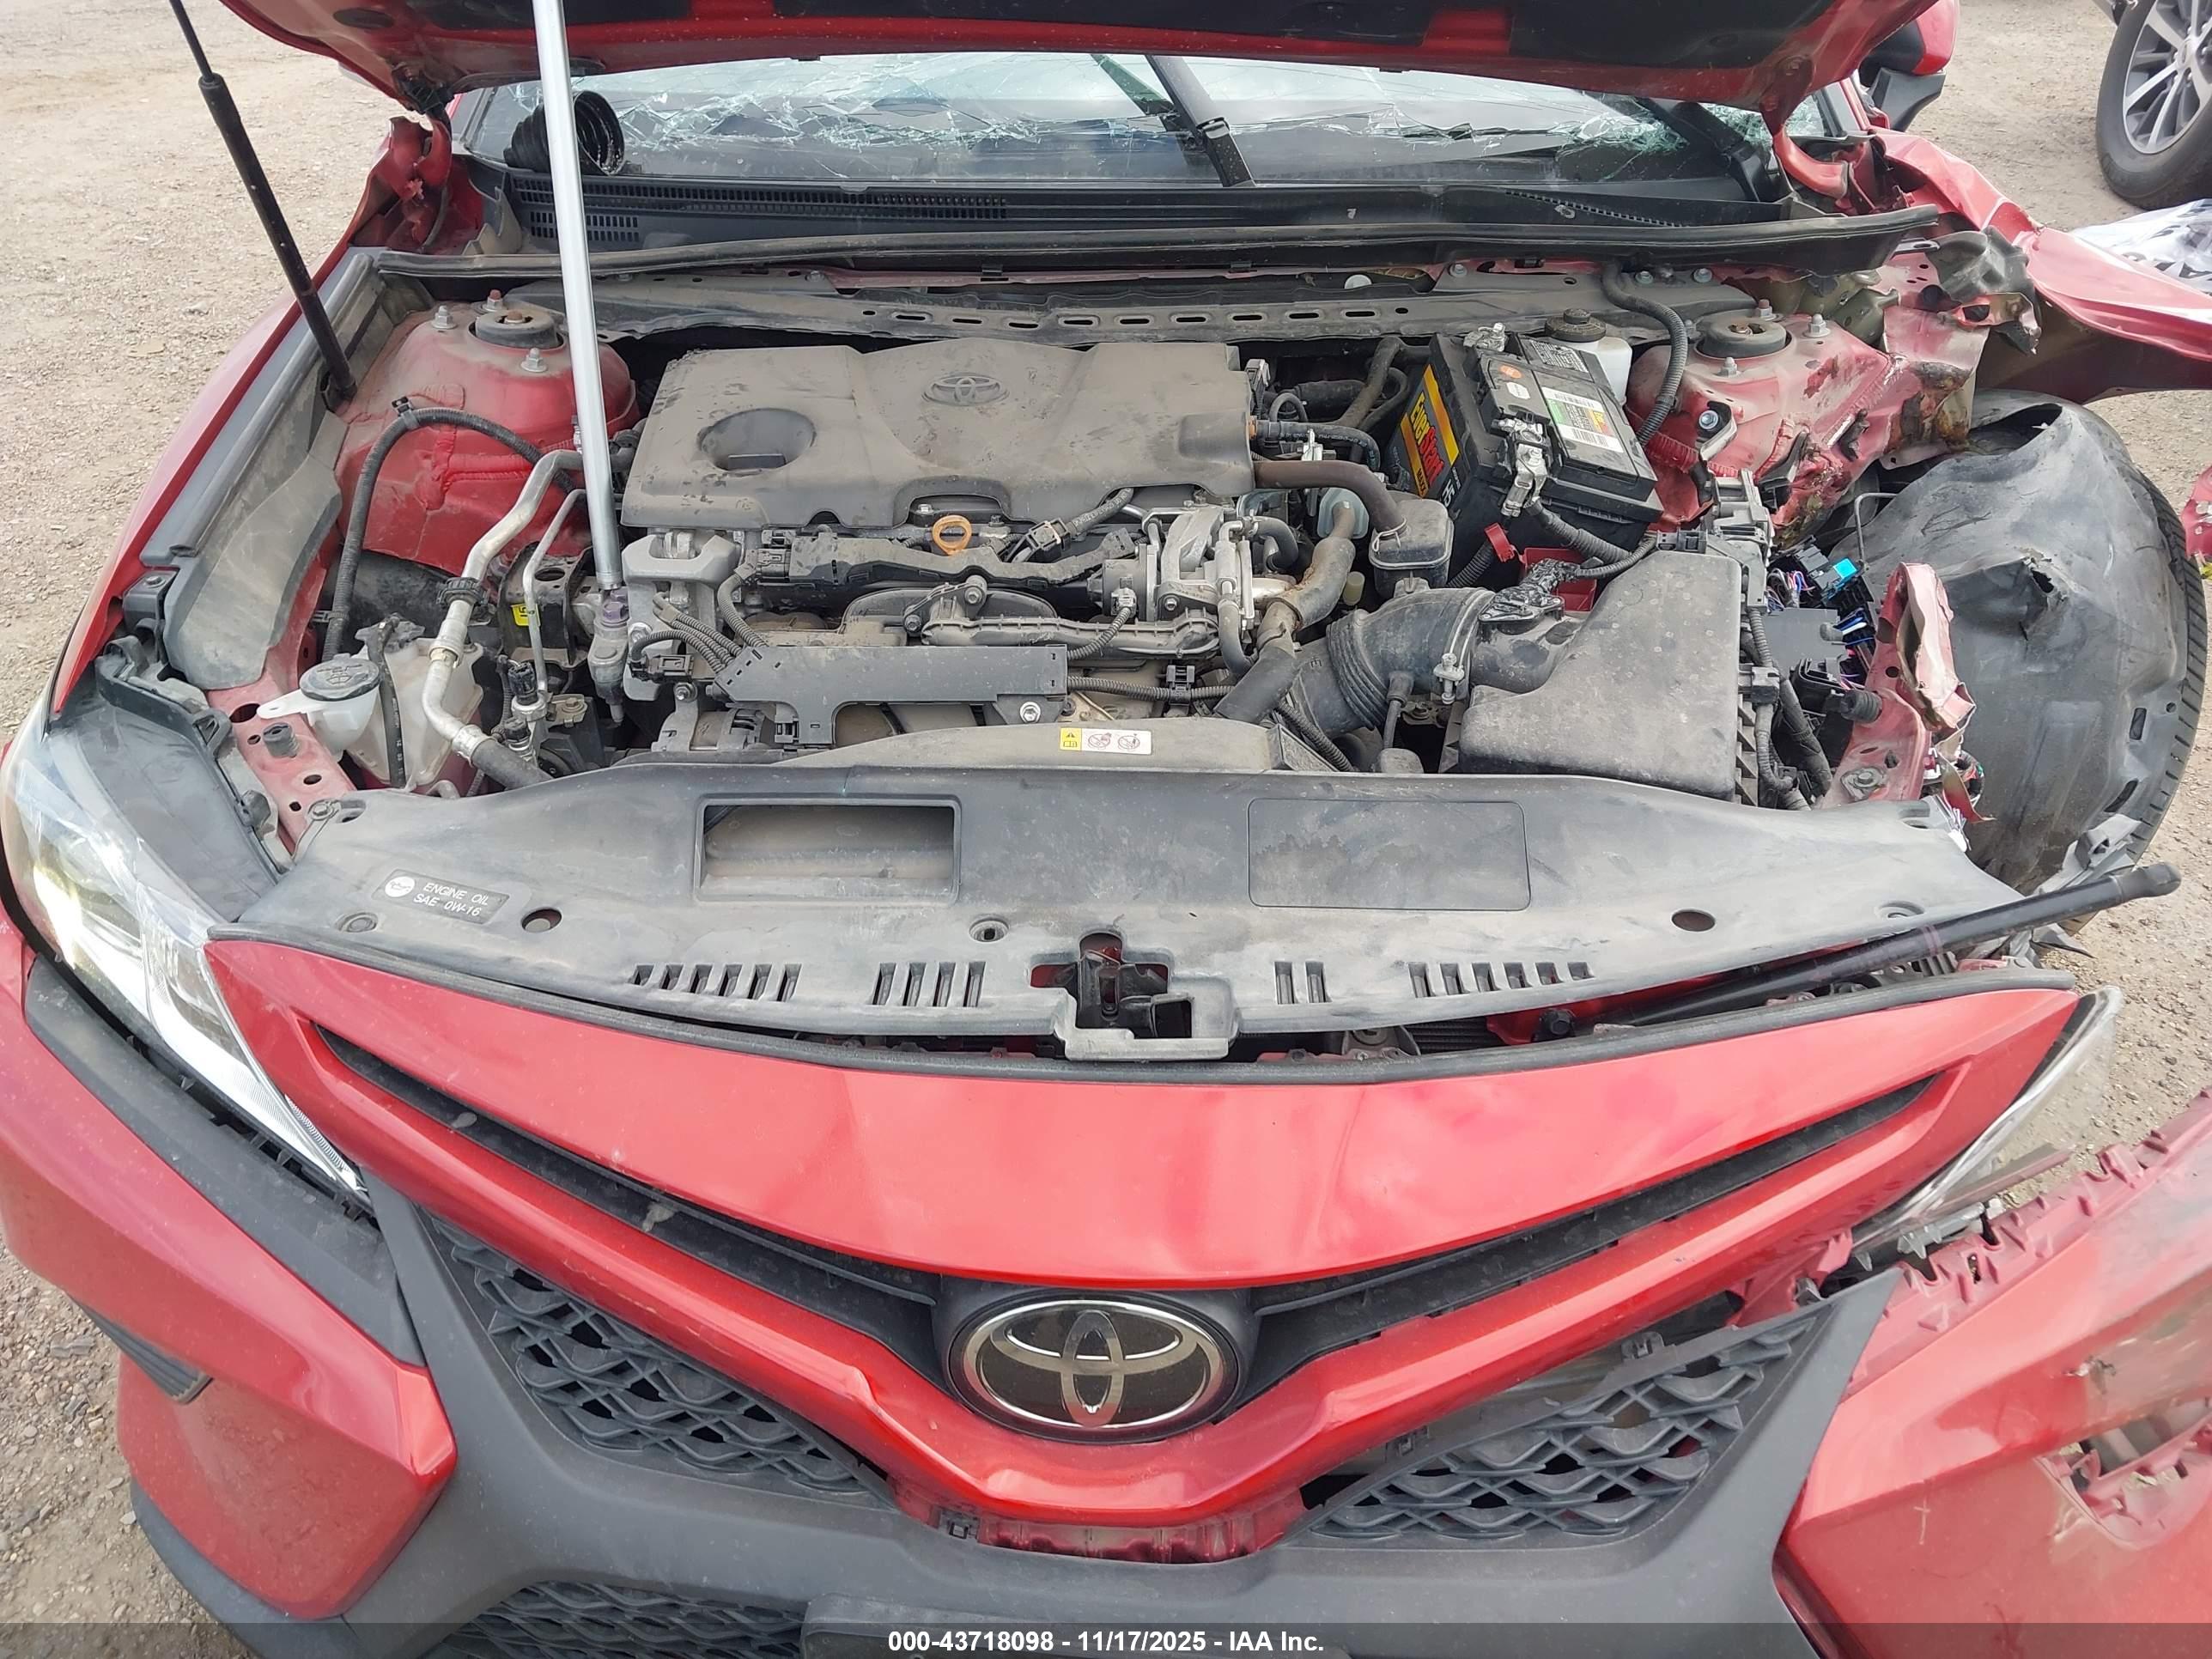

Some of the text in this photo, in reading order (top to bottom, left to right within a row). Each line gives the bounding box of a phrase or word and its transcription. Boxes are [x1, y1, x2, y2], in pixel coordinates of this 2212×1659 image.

[1410, 392, 1444, 489] EverStart
[1417, 468, 1426, 496] MAXX
[1442, 478, 1455, 507] H5
[413, 893, 482, 917] SAE 0W-16
[423, 882, 489, 906] ENGINE OIL
